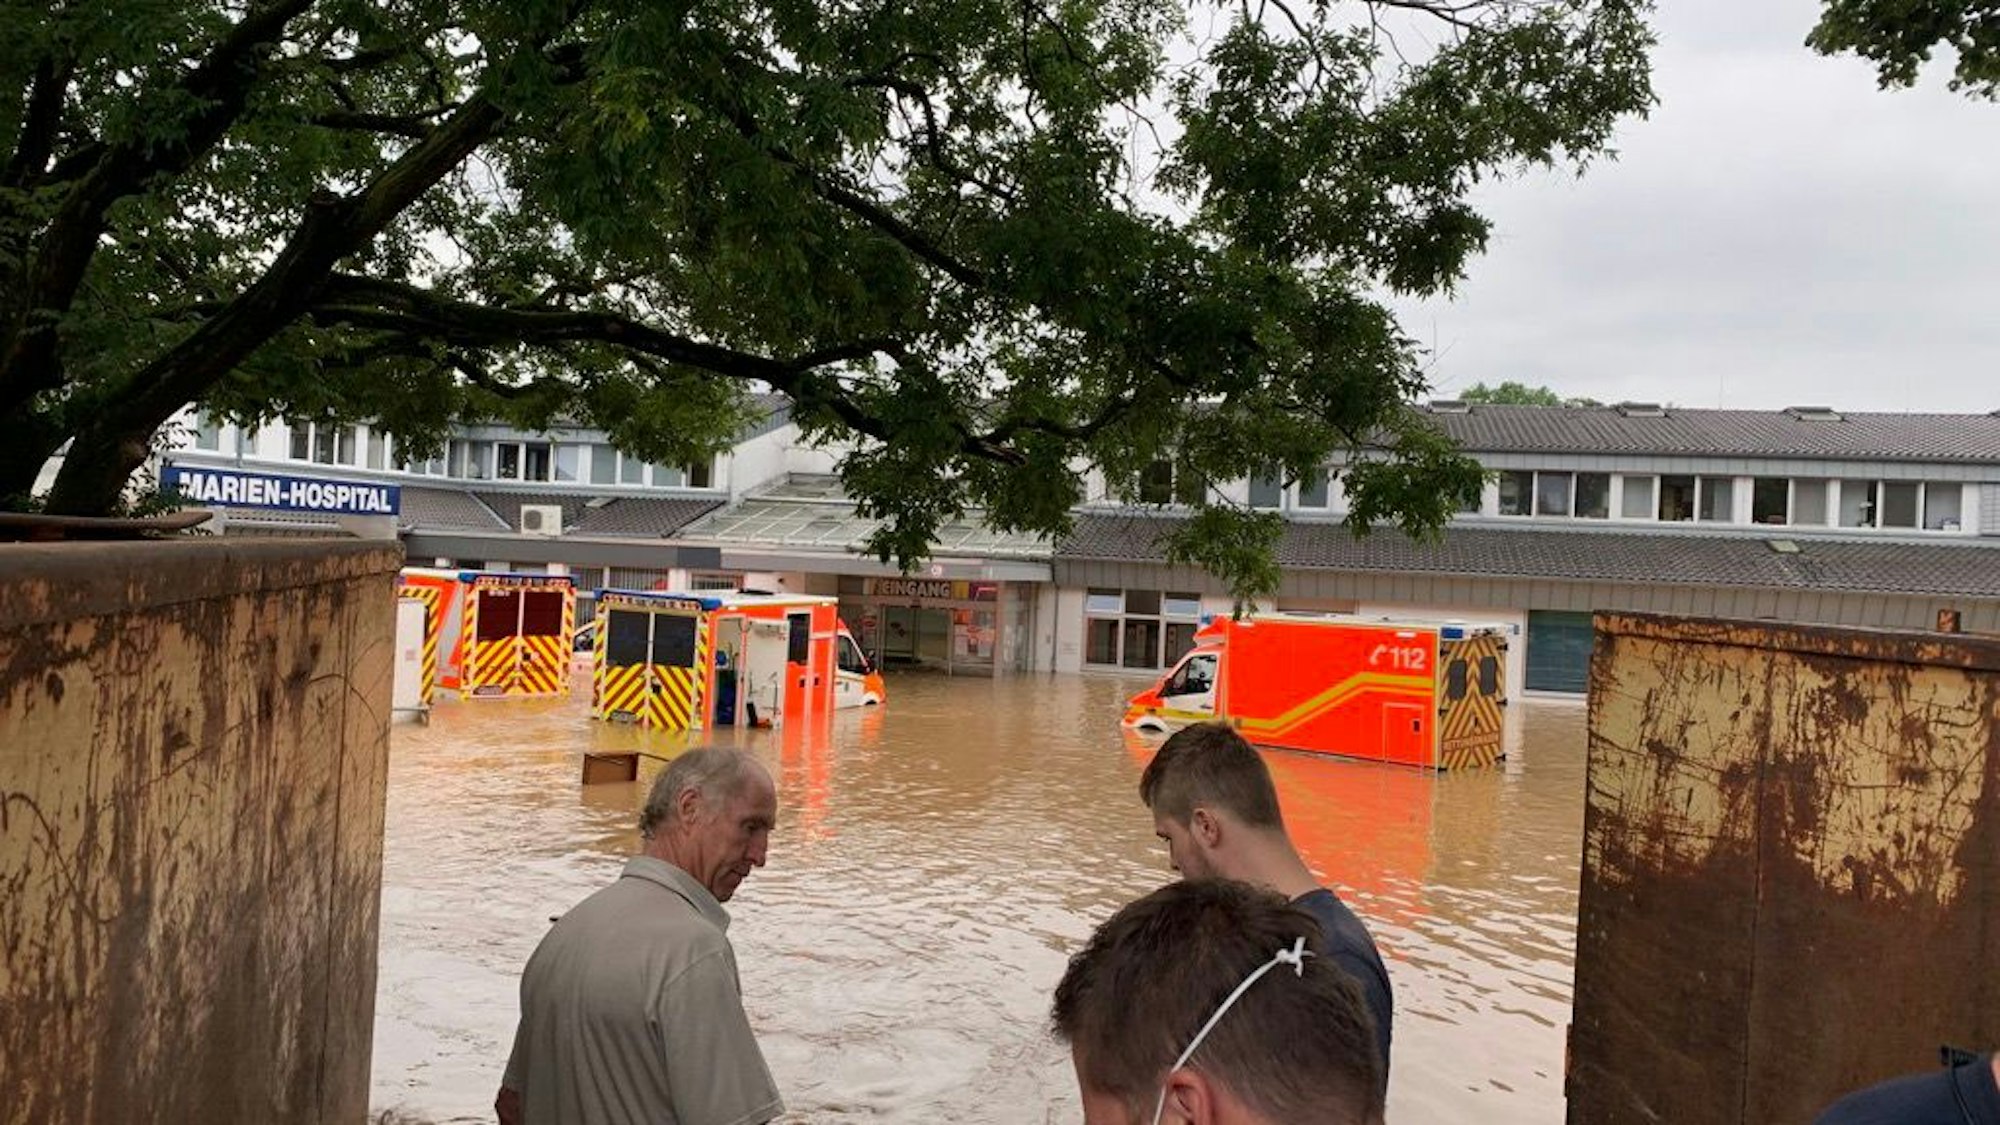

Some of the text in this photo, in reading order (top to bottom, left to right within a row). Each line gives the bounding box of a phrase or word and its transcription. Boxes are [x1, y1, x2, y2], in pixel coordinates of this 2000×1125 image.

[179, 472, 392, 513] MARIEN-HOSPITAL
[882, 580, 951, 598] EINGANG
[1389, 646, 1426, 669] 112
